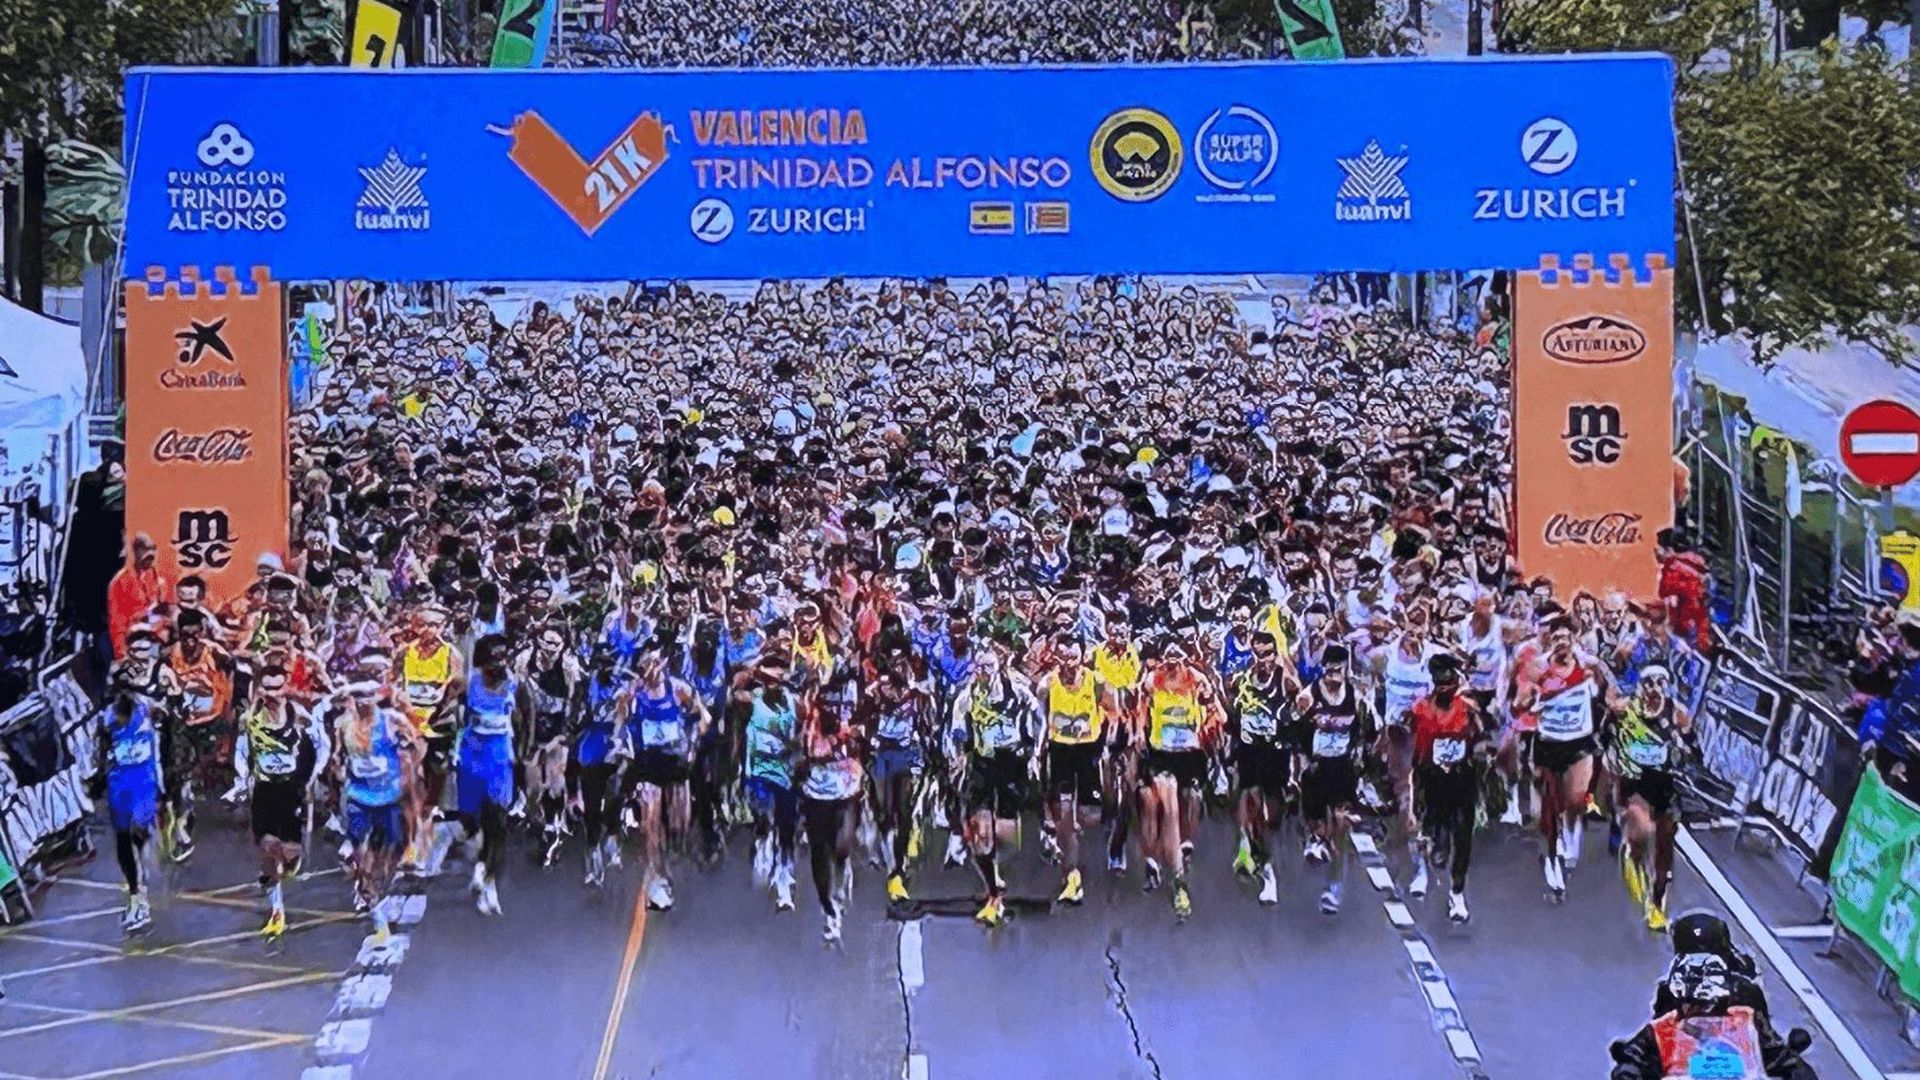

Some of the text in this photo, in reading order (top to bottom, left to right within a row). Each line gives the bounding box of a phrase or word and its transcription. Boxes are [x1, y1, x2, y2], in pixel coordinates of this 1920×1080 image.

[690, 109, 868, 146] VALENCIA
[584, 134, 652, 213] 21K
[691, 156, 1072, 189] TRINIDAD ALFONSO
[167, 187, 287, 209] TRINIDAD
[1473, 186, 1626, 220] ZURICH
[167, 209, 287, 231] ALFONSO
[747, 205, 867, 234] ZURICH
